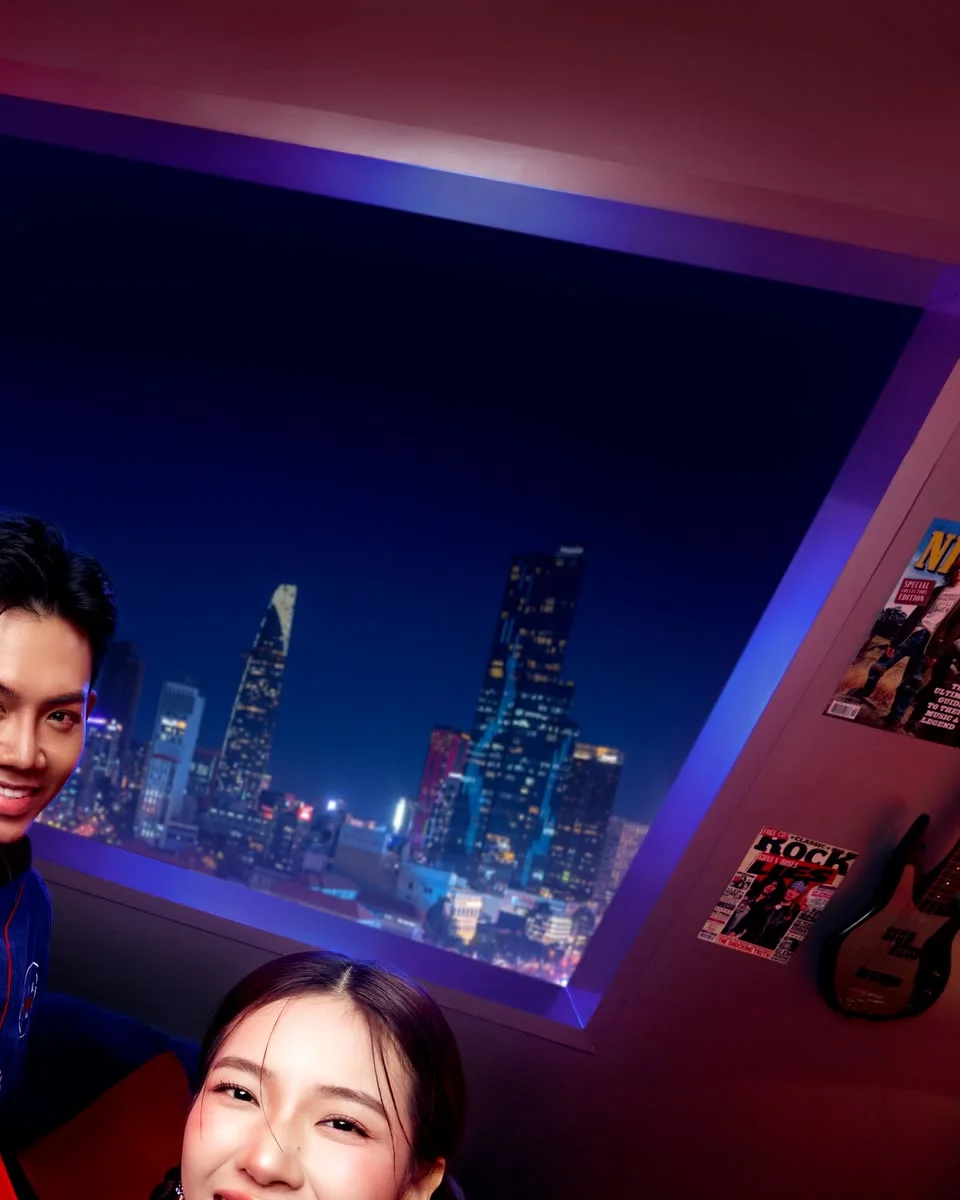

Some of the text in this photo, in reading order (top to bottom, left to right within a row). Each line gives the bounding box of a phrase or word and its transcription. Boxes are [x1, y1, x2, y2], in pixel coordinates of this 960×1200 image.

[903, 580, 930, 589] SPECIAL
[898, 594, 926, 602] EDITION
[927, 702, 939, 710] TO
[924, 710, 953, 721] MUSIC
[920, 716, 956, 730] LEGEND
[794, 836, 826, 849] CLASSIC
[754, 835, 859, 876] ROCK
